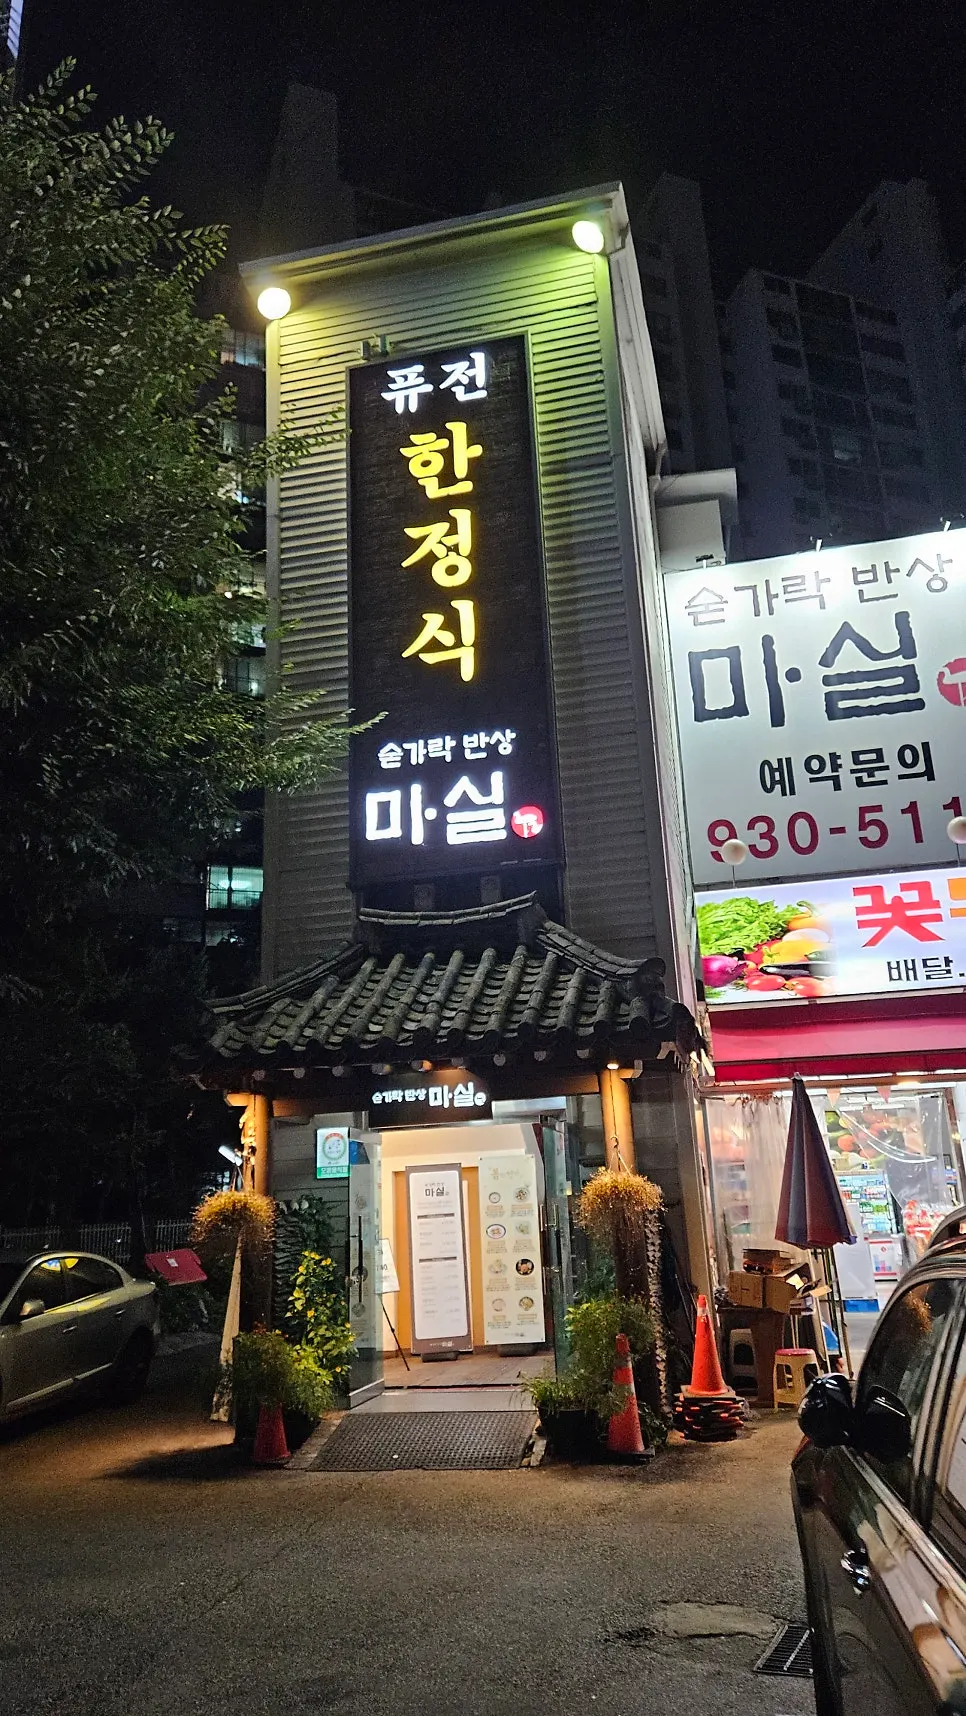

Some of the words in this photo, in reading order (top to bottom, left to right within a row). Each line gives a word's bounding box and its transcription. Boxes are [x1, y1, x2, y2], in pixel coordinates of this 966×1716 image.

[380, 351, 489, 415] 퓨전
[399, 421, 484, 682] 한정식
[684, 571, 831, 627] 숟가락
[852, 553, 953, 603] 반상
[377, 735, 457, 769] 숟가락
[462, 728, 517, 760] 반상
[759, 741, 936, 797] 예약문의
[404, 1088, 427, 1102] 반상
